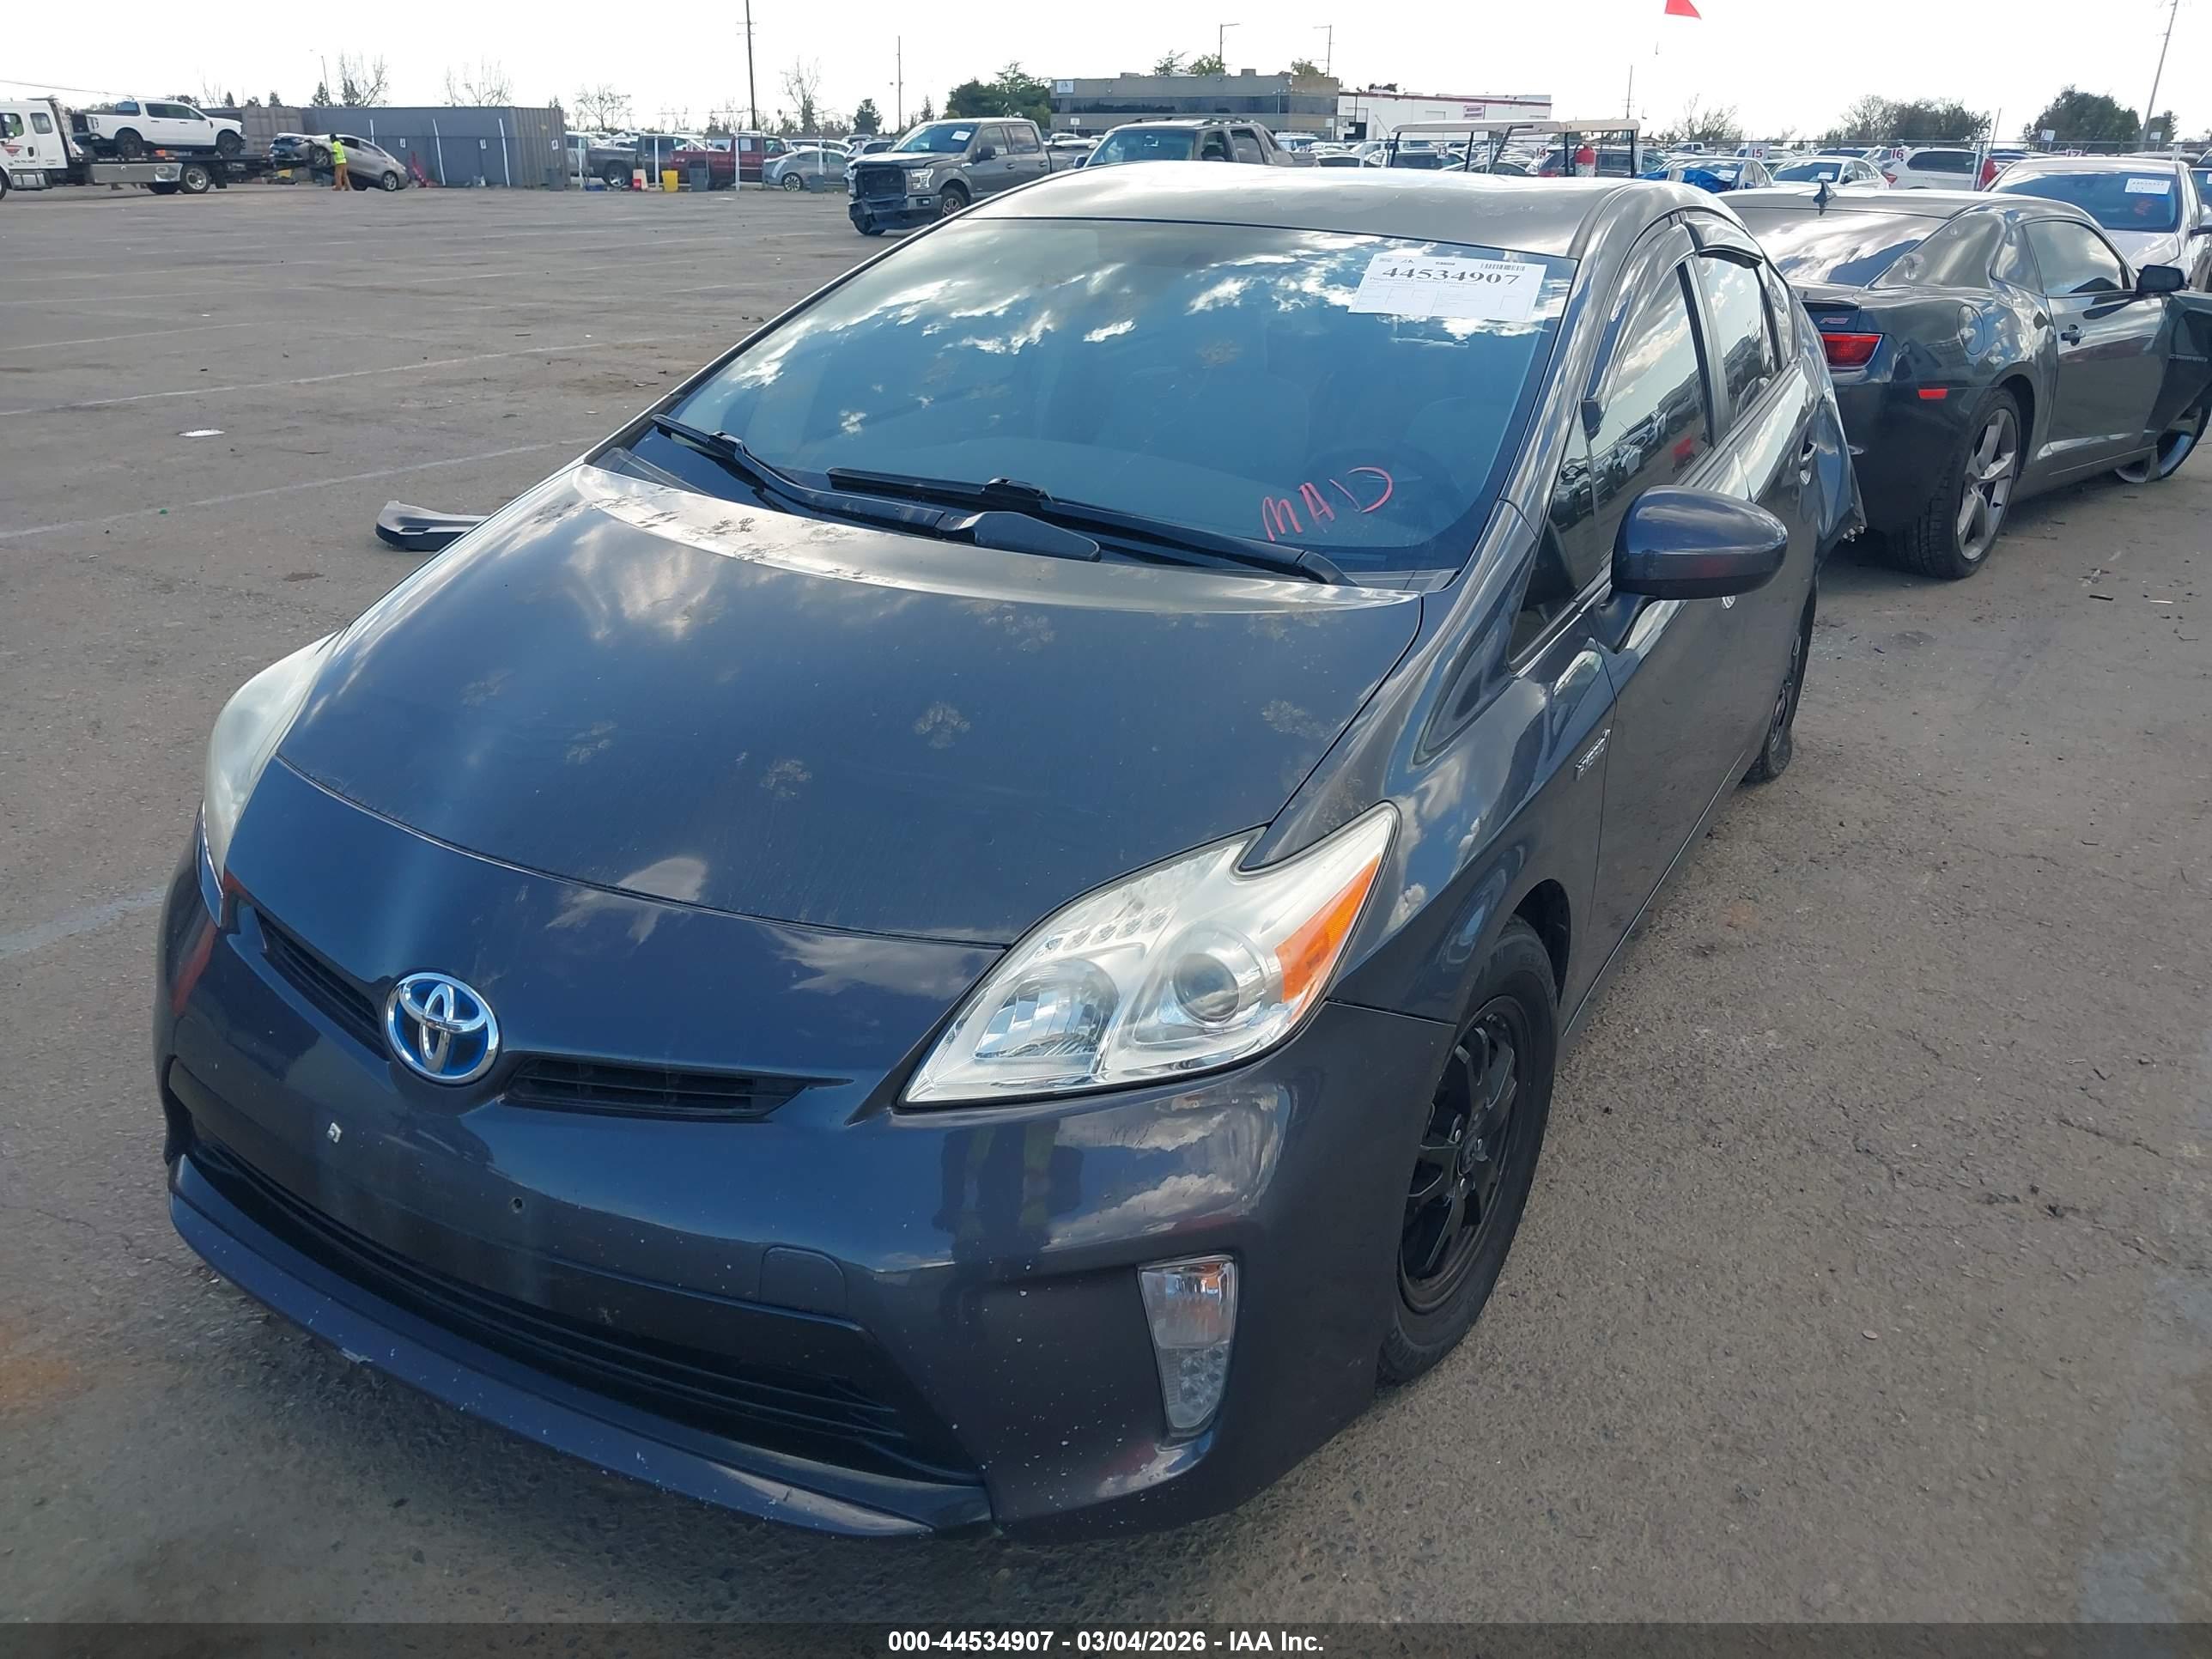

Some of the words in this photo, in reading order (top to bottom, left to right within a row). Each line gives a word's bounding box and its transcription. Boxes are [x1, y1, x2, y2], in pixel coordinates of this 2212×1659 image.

[1438, 146, 1448, 155] 13
[1536, 148, 1547, 158] 14
[1752, 149, 1763, 158] 15
[1892, 149, 1904, 159] 16
[1382, 267, 1520, 285] 44534907
[1261, 466, 1394, 542] MAD
